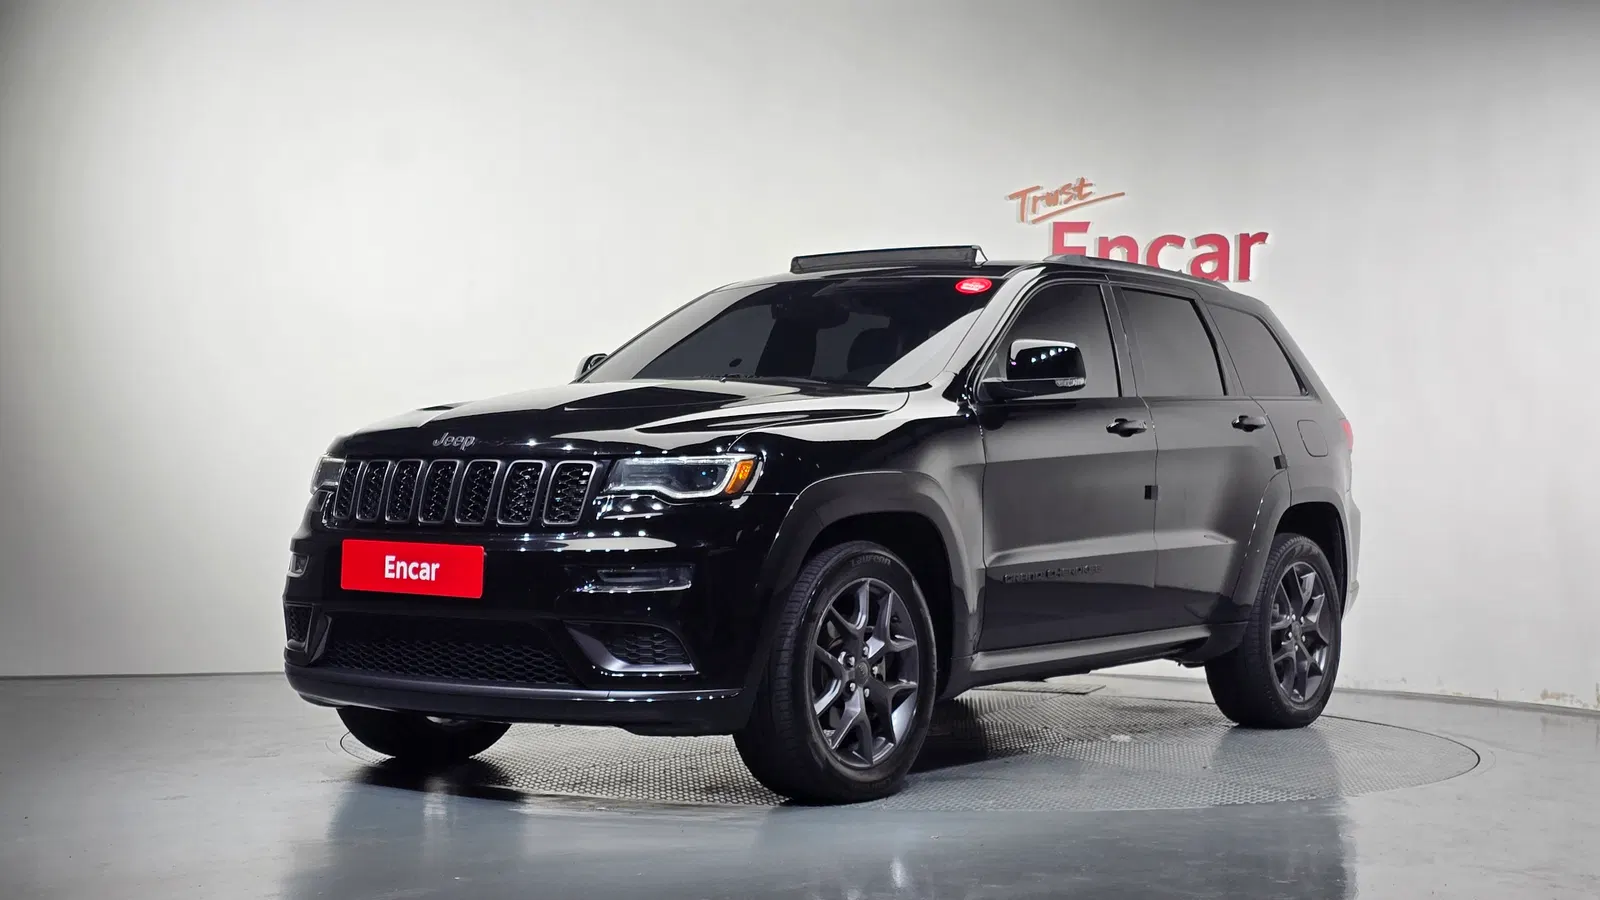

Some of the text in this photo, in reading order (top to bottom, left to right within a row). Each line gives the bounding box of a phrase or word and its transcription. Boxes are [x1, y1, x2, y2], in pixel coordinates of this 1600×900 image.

[1007, 177, 1094, 222] Trust
[1052, 221, 1269, 282] Encar
[432, 432, 475, 451] Jeep
[384, 555, 440, 581] Encar
